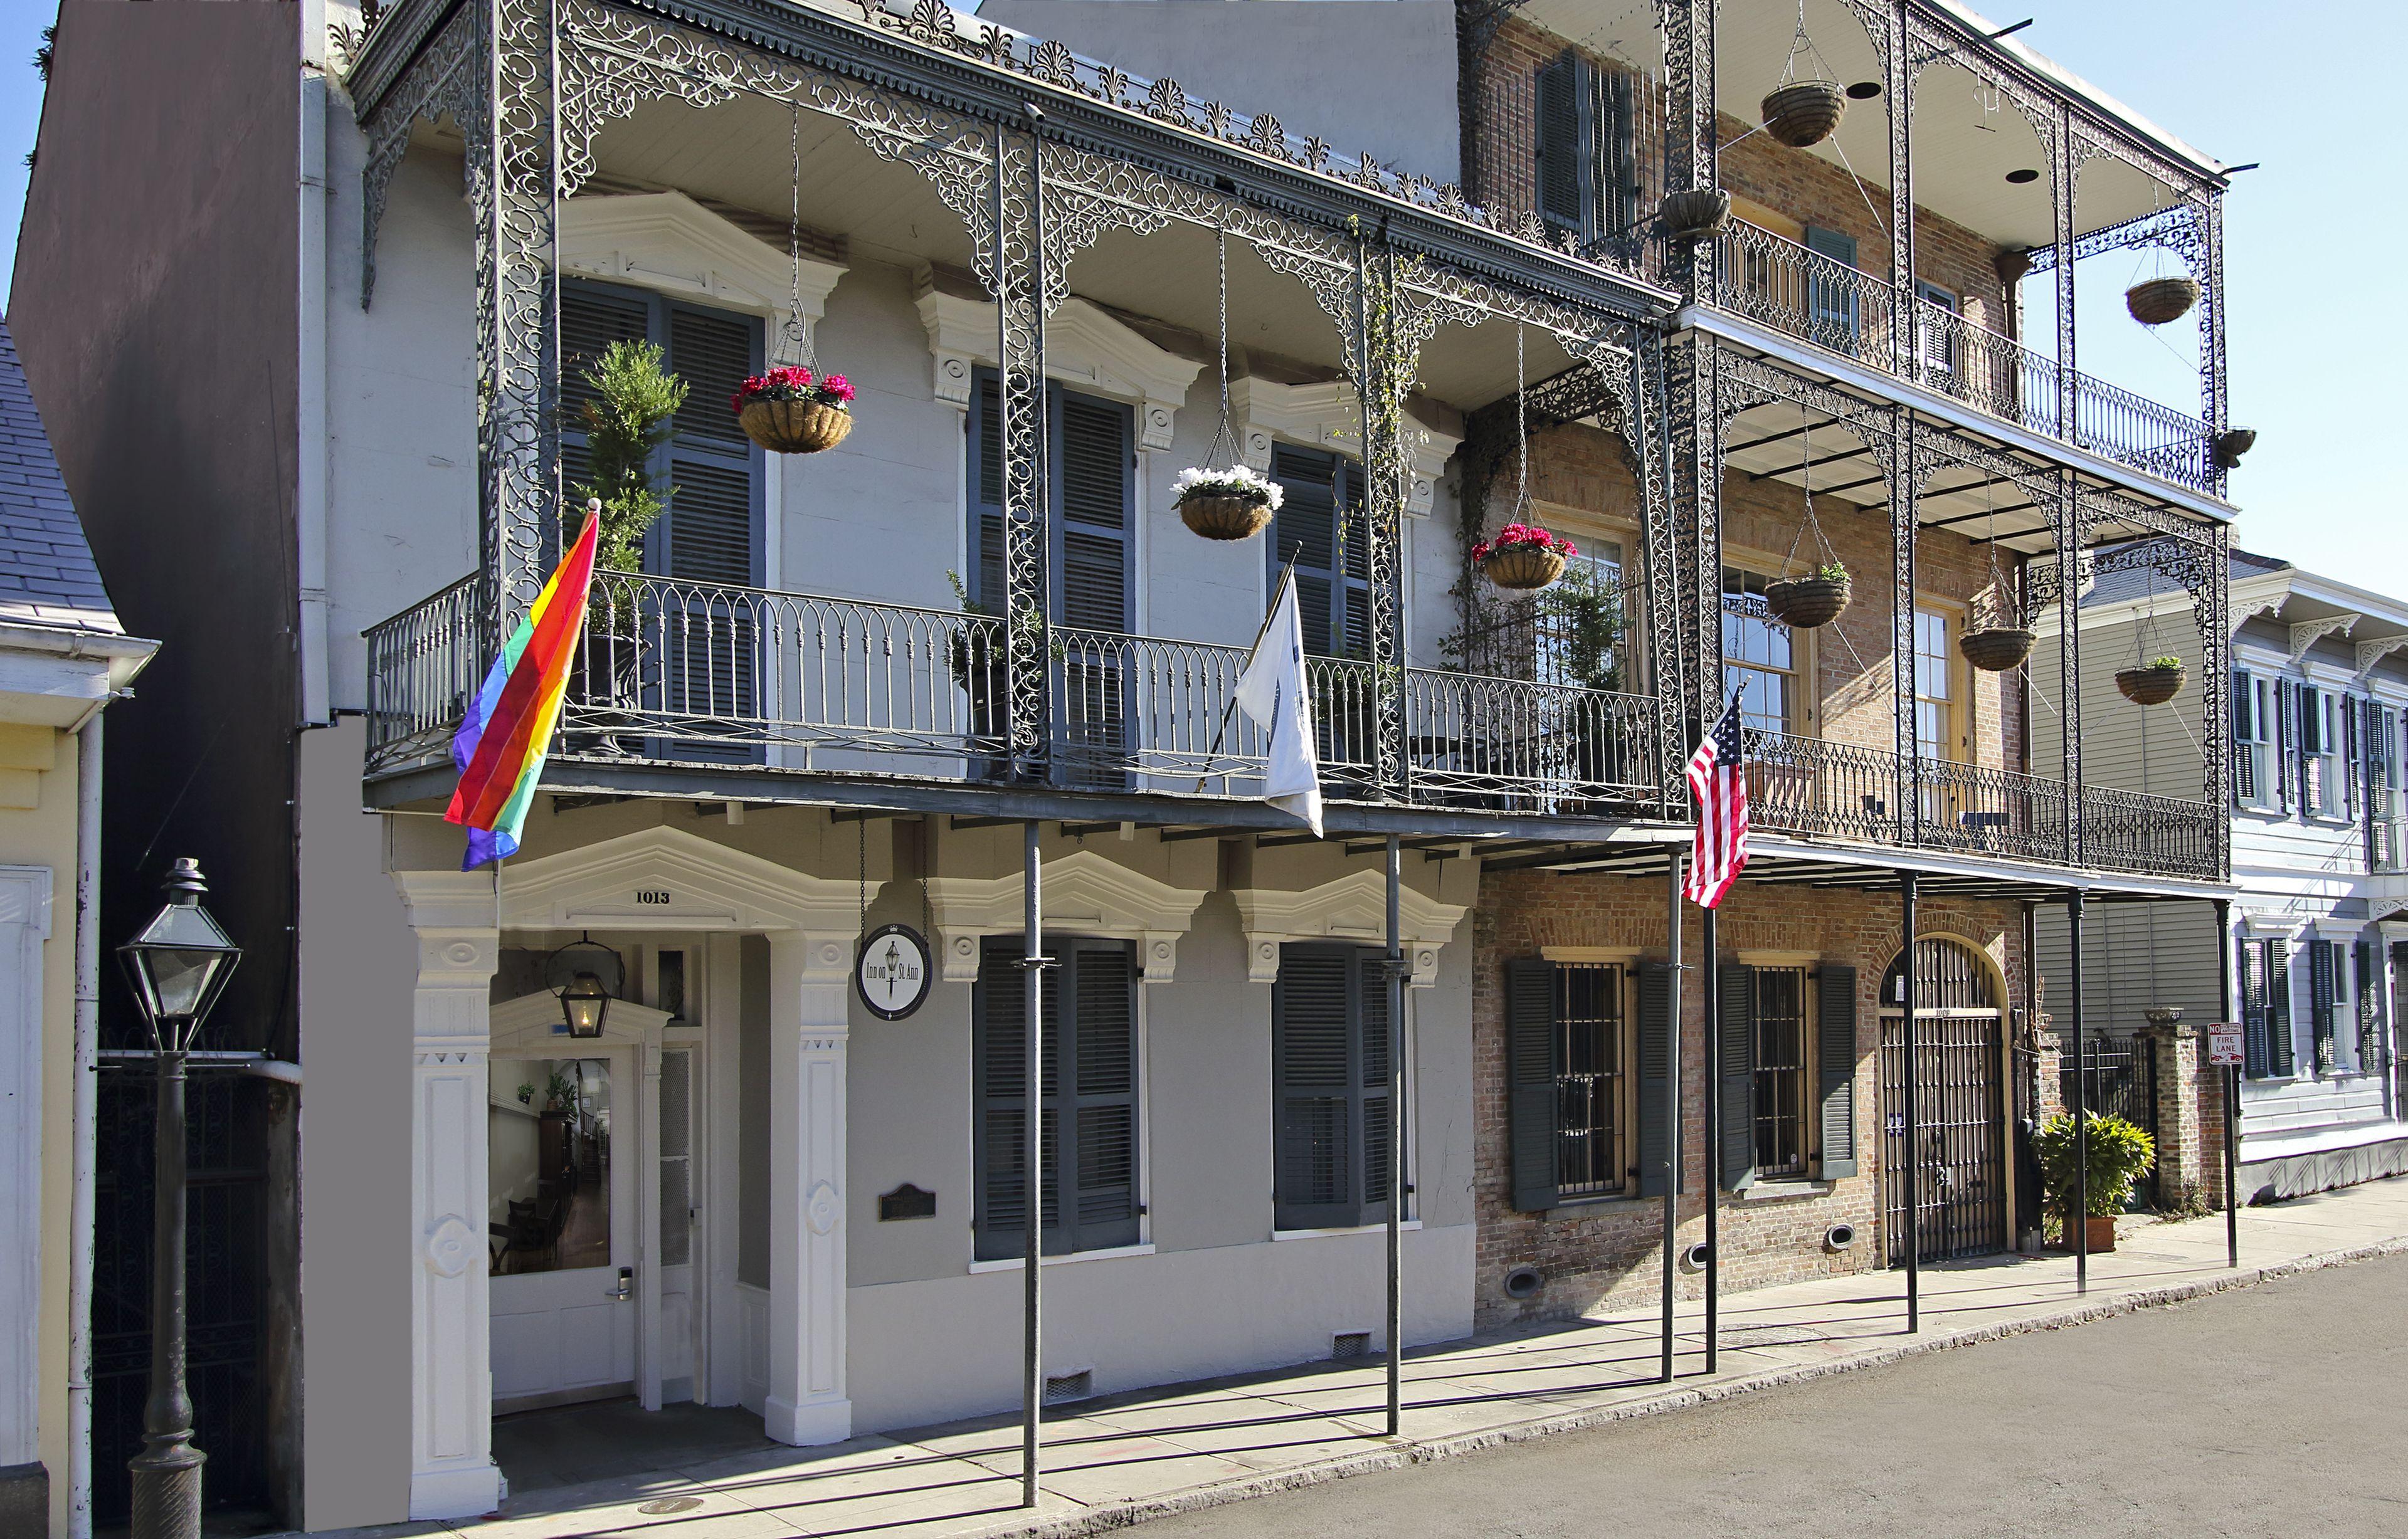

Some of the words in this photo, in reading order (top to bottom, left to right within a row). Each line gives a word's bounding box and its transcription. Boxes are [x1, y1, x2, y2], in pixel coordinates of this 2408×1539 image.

[636, 891, 670, 904] 1013
[867, 962, 877, 979] Inn
[879, 966, 885, 979] on
[899, 963, 905, 979] St
[906, 963, 918, 980] Ann
[2209, 1025, 2220, 1034] NO
